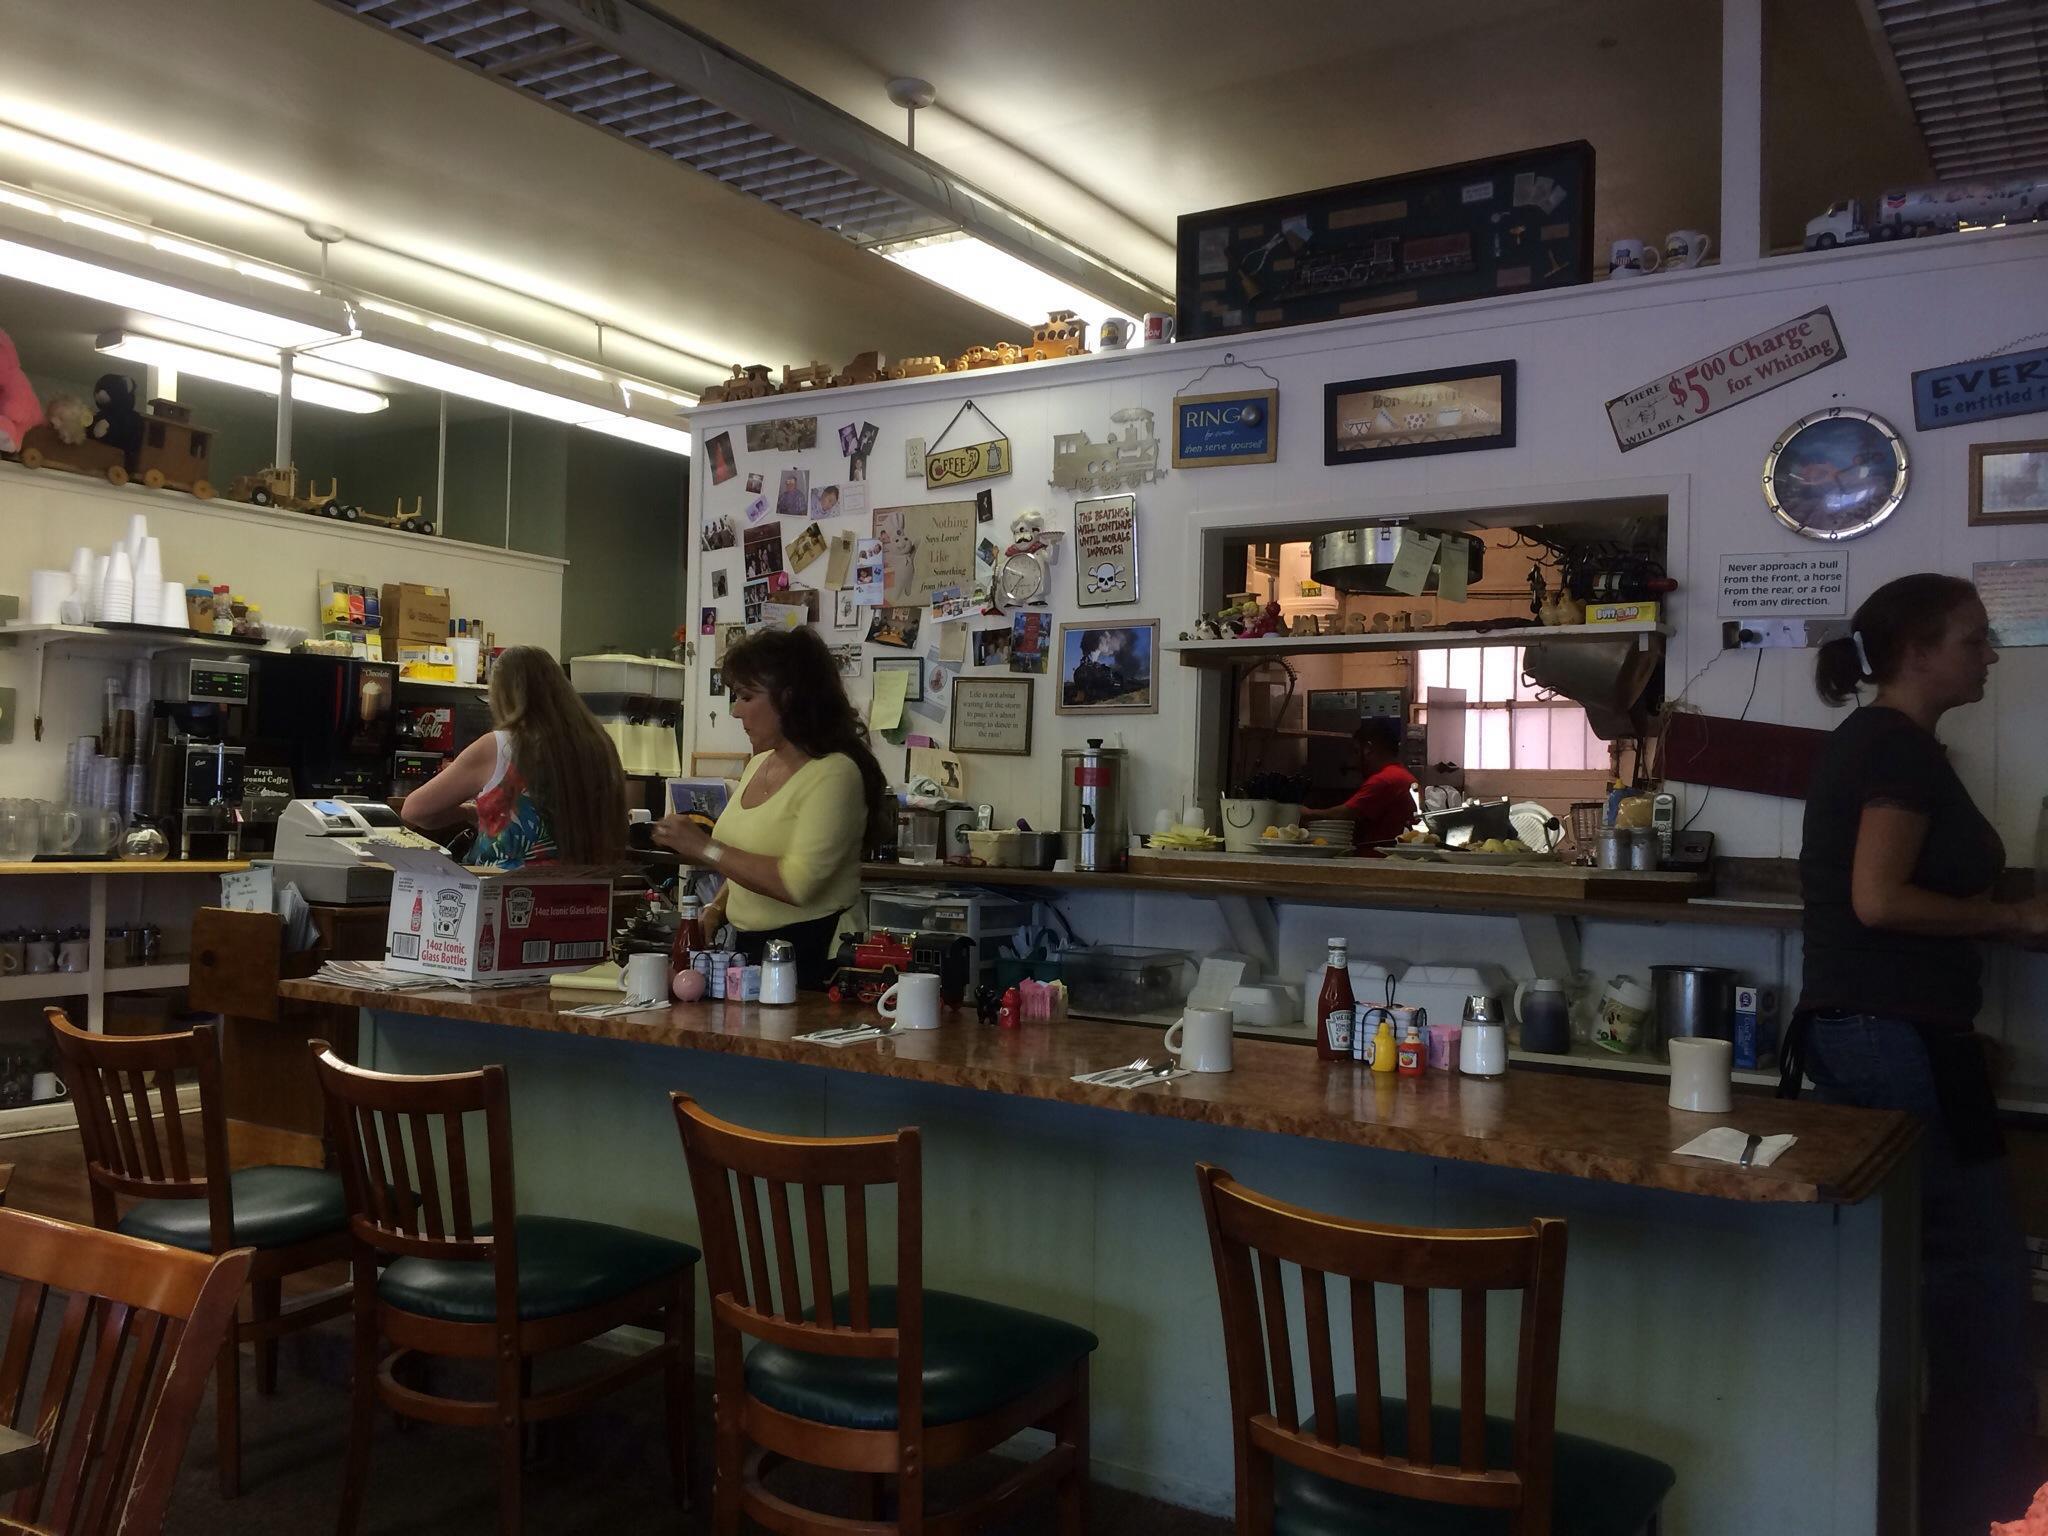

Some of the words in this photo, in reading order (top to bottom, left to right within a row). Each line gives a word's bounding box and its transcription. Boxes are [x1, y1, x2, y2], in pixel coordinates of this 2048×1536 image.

[1728, 321, 1813, 367] Charge
[1726, 374, 1752, 395] for
[1754, 338, 1835, 382] Whining
[1932, 358, 2048, 399] EVER
[1623, 384, 1662, 407] THERE
[1934, 403, 1949, 417] is
[1954, 388, 2033, 413] entitled
[1186, 408, 1241, 428] RING
[1625, 428, 1656, 447] WILL
[1657, 420, 1673, 433] BE
[1676, 415, 1685, 424] A
[1204, 444, 1227, 452] serve
[1231, 440, 1265, 452] yourself
[932, 516, 969, 529] Nothing
[1079, 511, 1092, 523] THE
[1095, 507, 1130, 521] BEATINGS
[1078, 523, 1096, 536] WILL
[1098, 519, 1133, 533] CONTINUE
[1080, 535, 1101, 547] UNTIL
[1102, 532, 1131, 543] MORALE
[930, 551, 949, 563] Like
[933, 566, 967, 576] Something
[1728, 564, 1757, 572] Never
[1759, 562, 1807, 572] approach
[1810, 562, 1816, 570] a
[1819, 560, 1838, 570] bull
[1724, 575, 1749, 584] from
[1751, 574, 1769, 583] the
[1771, 574, 1801, 583] front,
[1812, 573, 1842, 582] horse
[1724, 587, 1749, 596] from
[1751, 586, 1769, 595] the
[1797, 586, 1808, 594] or
[1819, 585, 1841, 594] fool
[1732, 599, 1757, 607] from
[1760, 599, 1778, 607] any
[253, 768, 273, 776] Fresh
[267, 776, 289, 785] Coffee
[550, 905, 569, 916] Iconic
[570, 904, 585, 915] Glass
[586, 904, 608, 915] Bottles
[426, 939, 443, 951] 14oz
[444, 941, 466, 955] Iconic
[421, 949, 441, 962] Glass
[441, 952, 468, 967] Bottles
